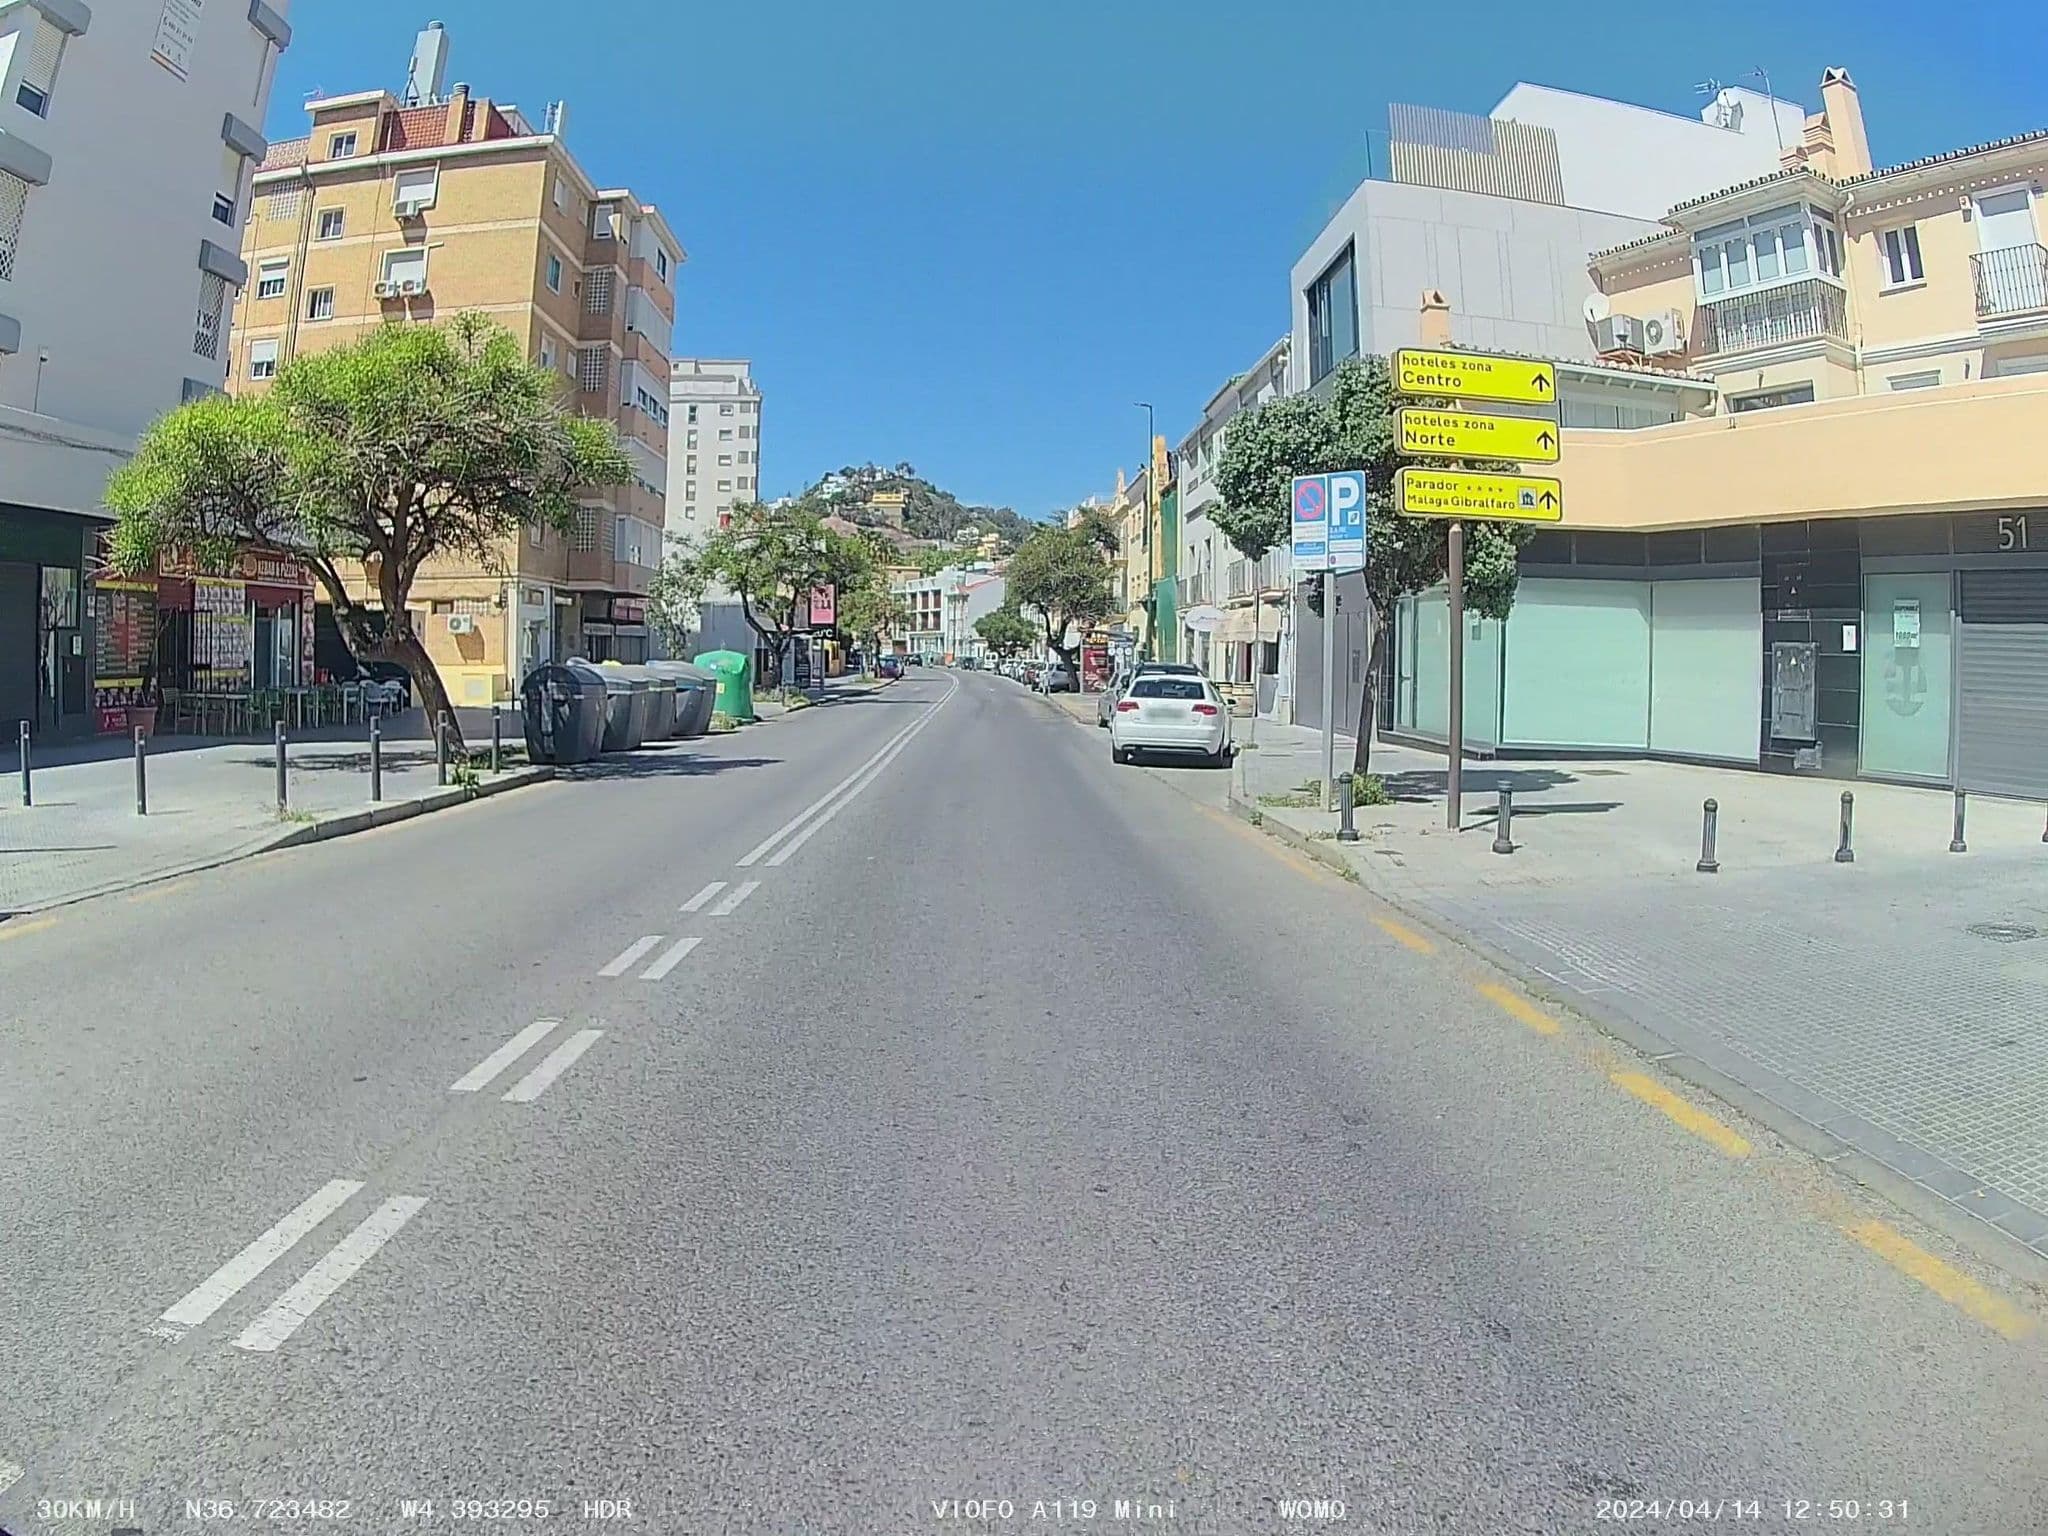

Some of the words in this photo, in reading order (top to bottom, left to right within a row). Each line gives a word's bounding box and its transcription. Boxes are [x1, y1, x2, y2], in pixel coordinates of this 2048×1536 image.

[1402, 354, 1456, 370] hoteles
[1462, 362, 1492, 372] zona
[1402, 370, 1462, 388] Centro
[1404, 414, 1459, 428] hoteles
[1463, 420, 1495, 431] zona
[1405, 430, 1456, 447] Norte
[1406, 477, 1459, 491] Parador
[1451, 496, 1516, 510] Gibralfaro
[1998, 516, 2027, 549] 51
